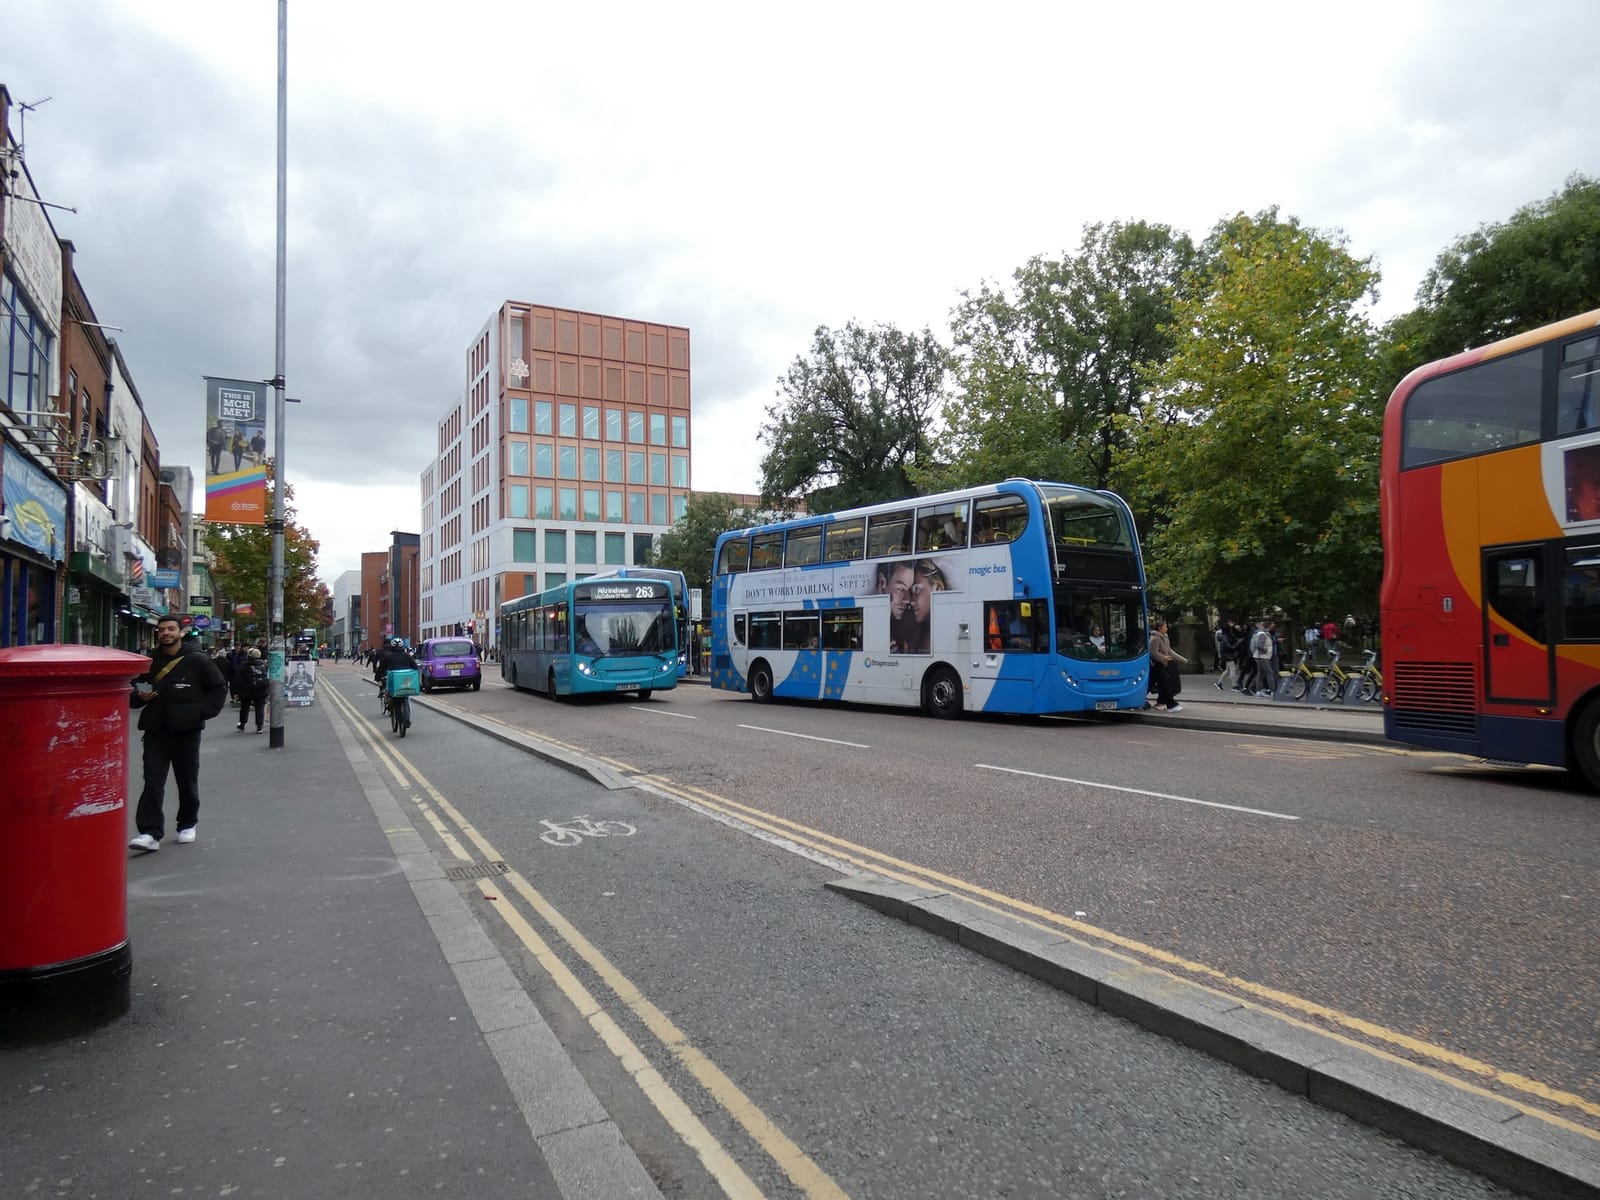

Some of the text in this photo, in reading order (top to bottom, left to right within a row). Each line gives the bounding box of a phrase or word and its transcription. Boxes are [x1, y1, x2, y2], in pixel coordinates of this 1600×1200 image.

[223, 399, 250, 409] MCR
[223, 407, 250, 417] MET
[968, 563, 1007, 576] magic bus
[839, 580, 858, 589] SEPT
[635, 586, 654, 598] 263
[745, 583, 833, 599] DON'T WORRY DARLING
